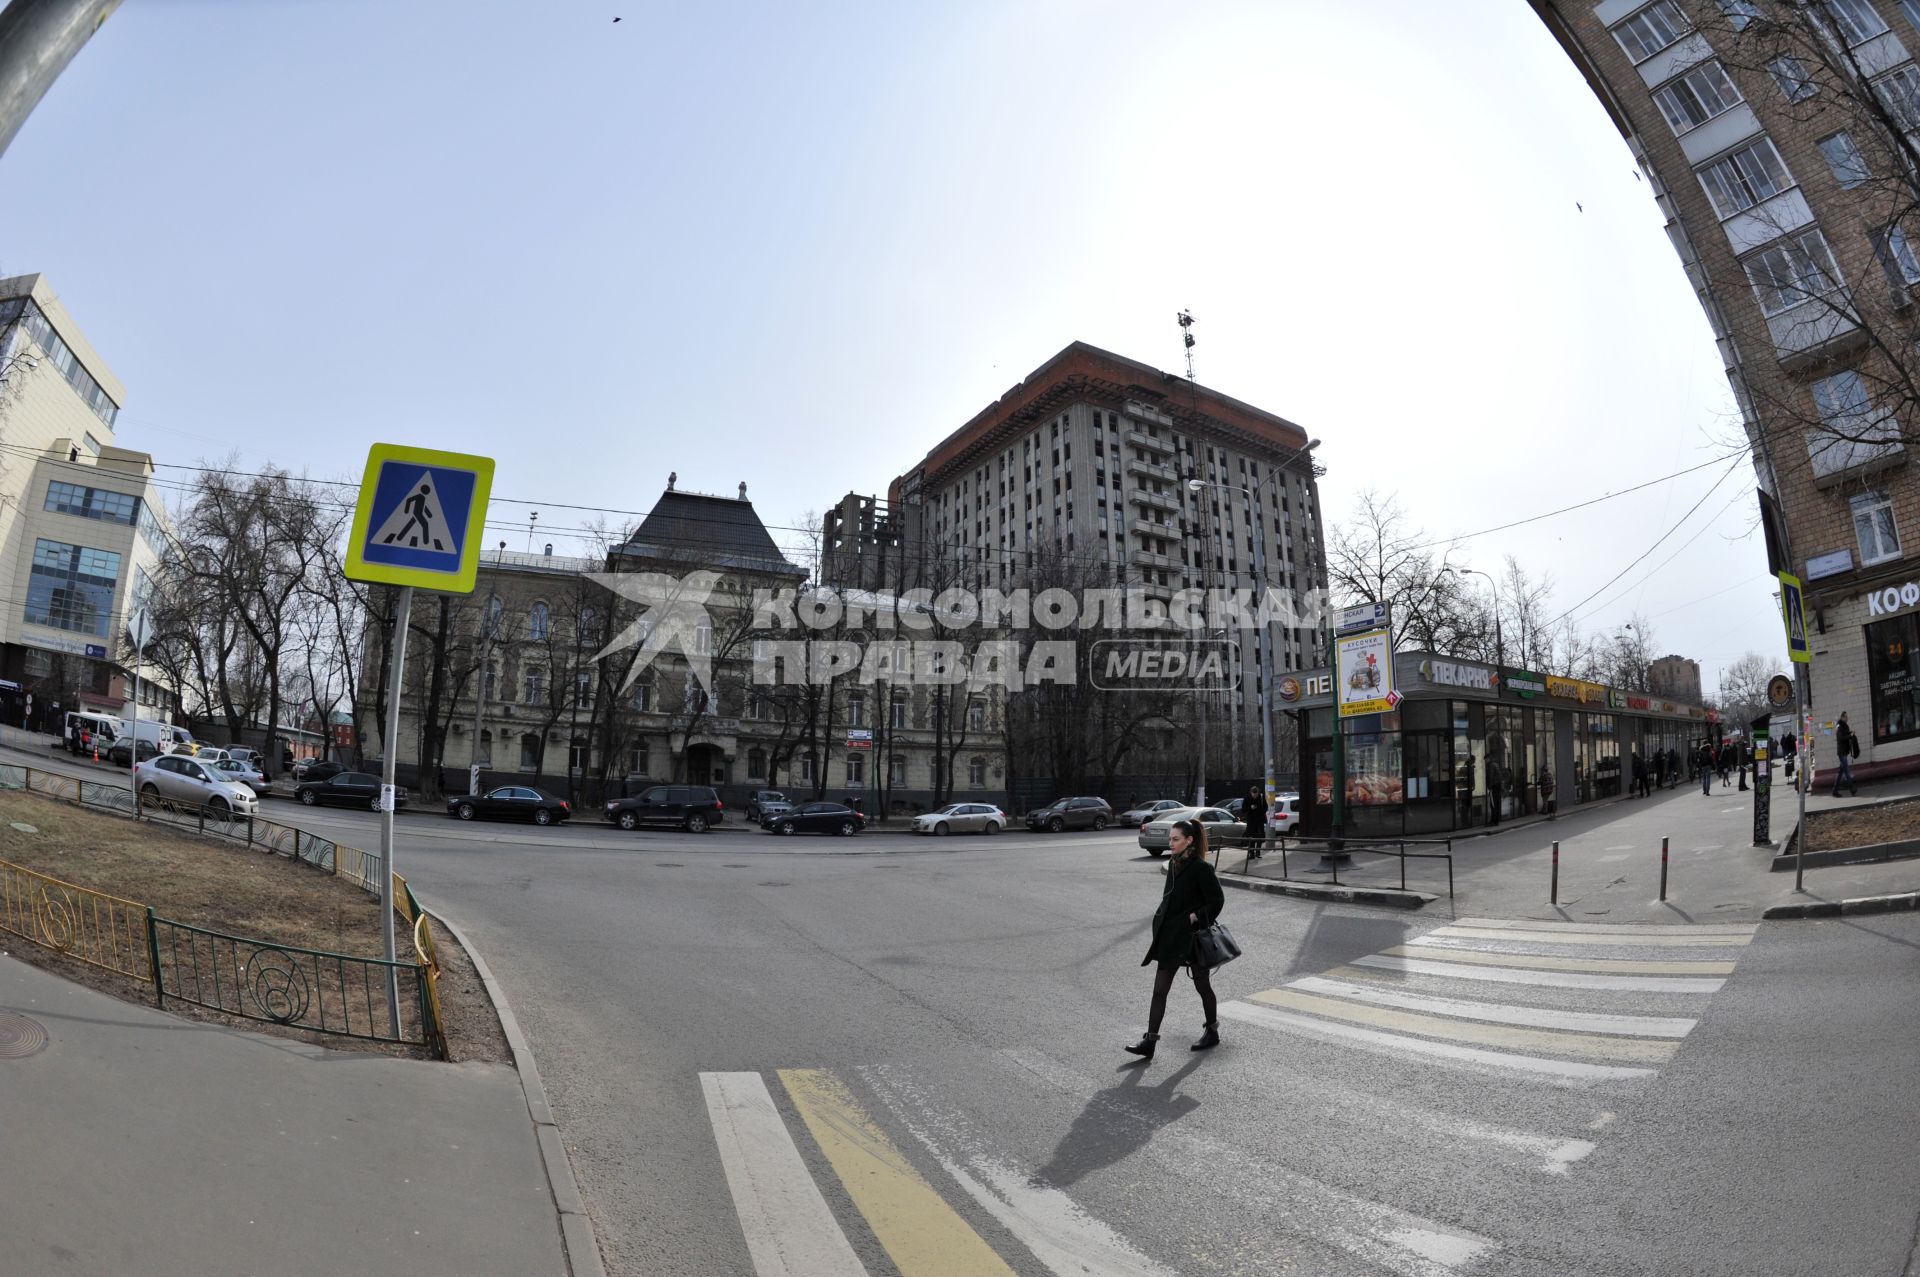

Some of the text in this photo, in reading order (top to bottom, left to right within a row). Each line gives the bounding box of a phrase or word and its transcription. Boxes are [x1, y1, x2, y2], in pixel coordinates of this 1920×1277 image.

[1867, 582, 1920, 617] КОФ
[1306, 674, 1334, 696] ПЕ
[1431, 660, 1490, 689] ПЕКАРНЯ
